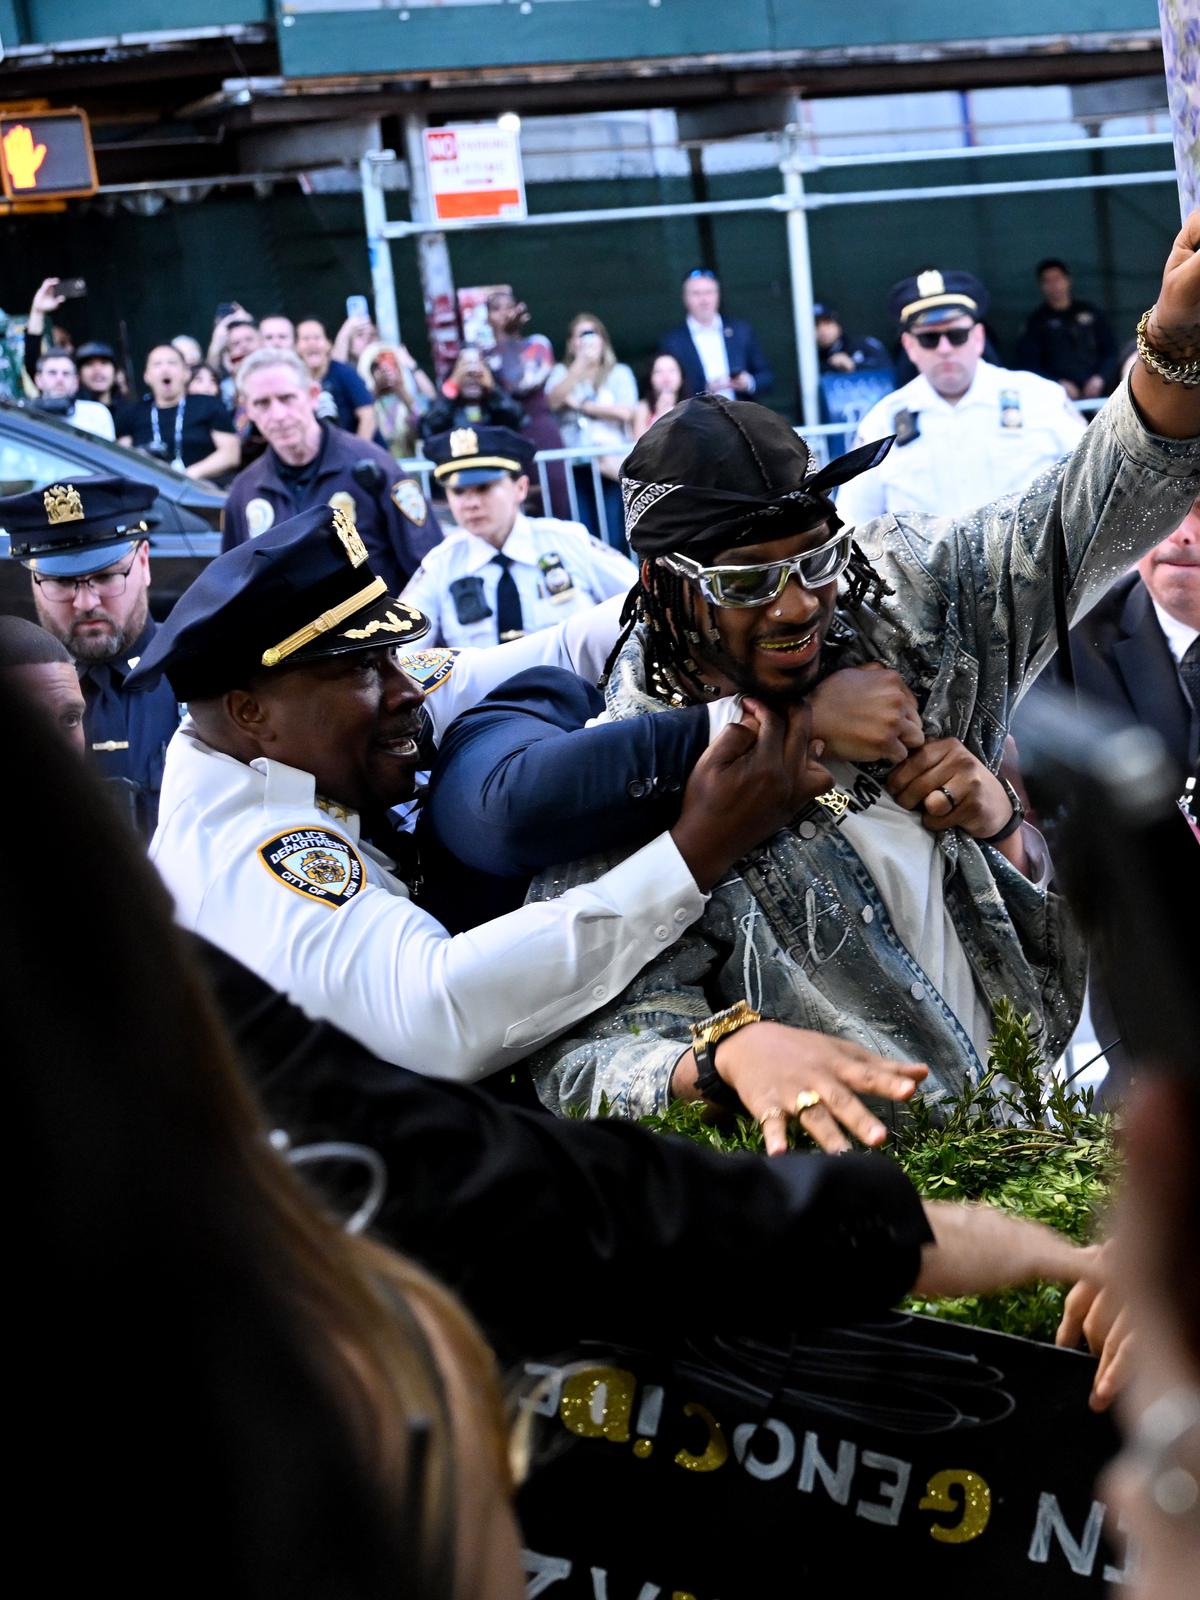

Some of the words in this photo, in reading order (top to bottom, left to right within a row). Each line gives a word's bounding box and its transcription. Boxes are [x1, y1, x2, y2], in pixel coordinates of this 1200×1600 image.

[430, 136, 455, 158] NO
[281, 832, 328, 845] POLICE
[270, 840, 349, 864] DEPARTMENT
[281, 872, 307, 888] CITY
[308, 887, 327, 896] OF
[342, 880, 358, 898] NEW
[351, 859, 361, 879] YORK
